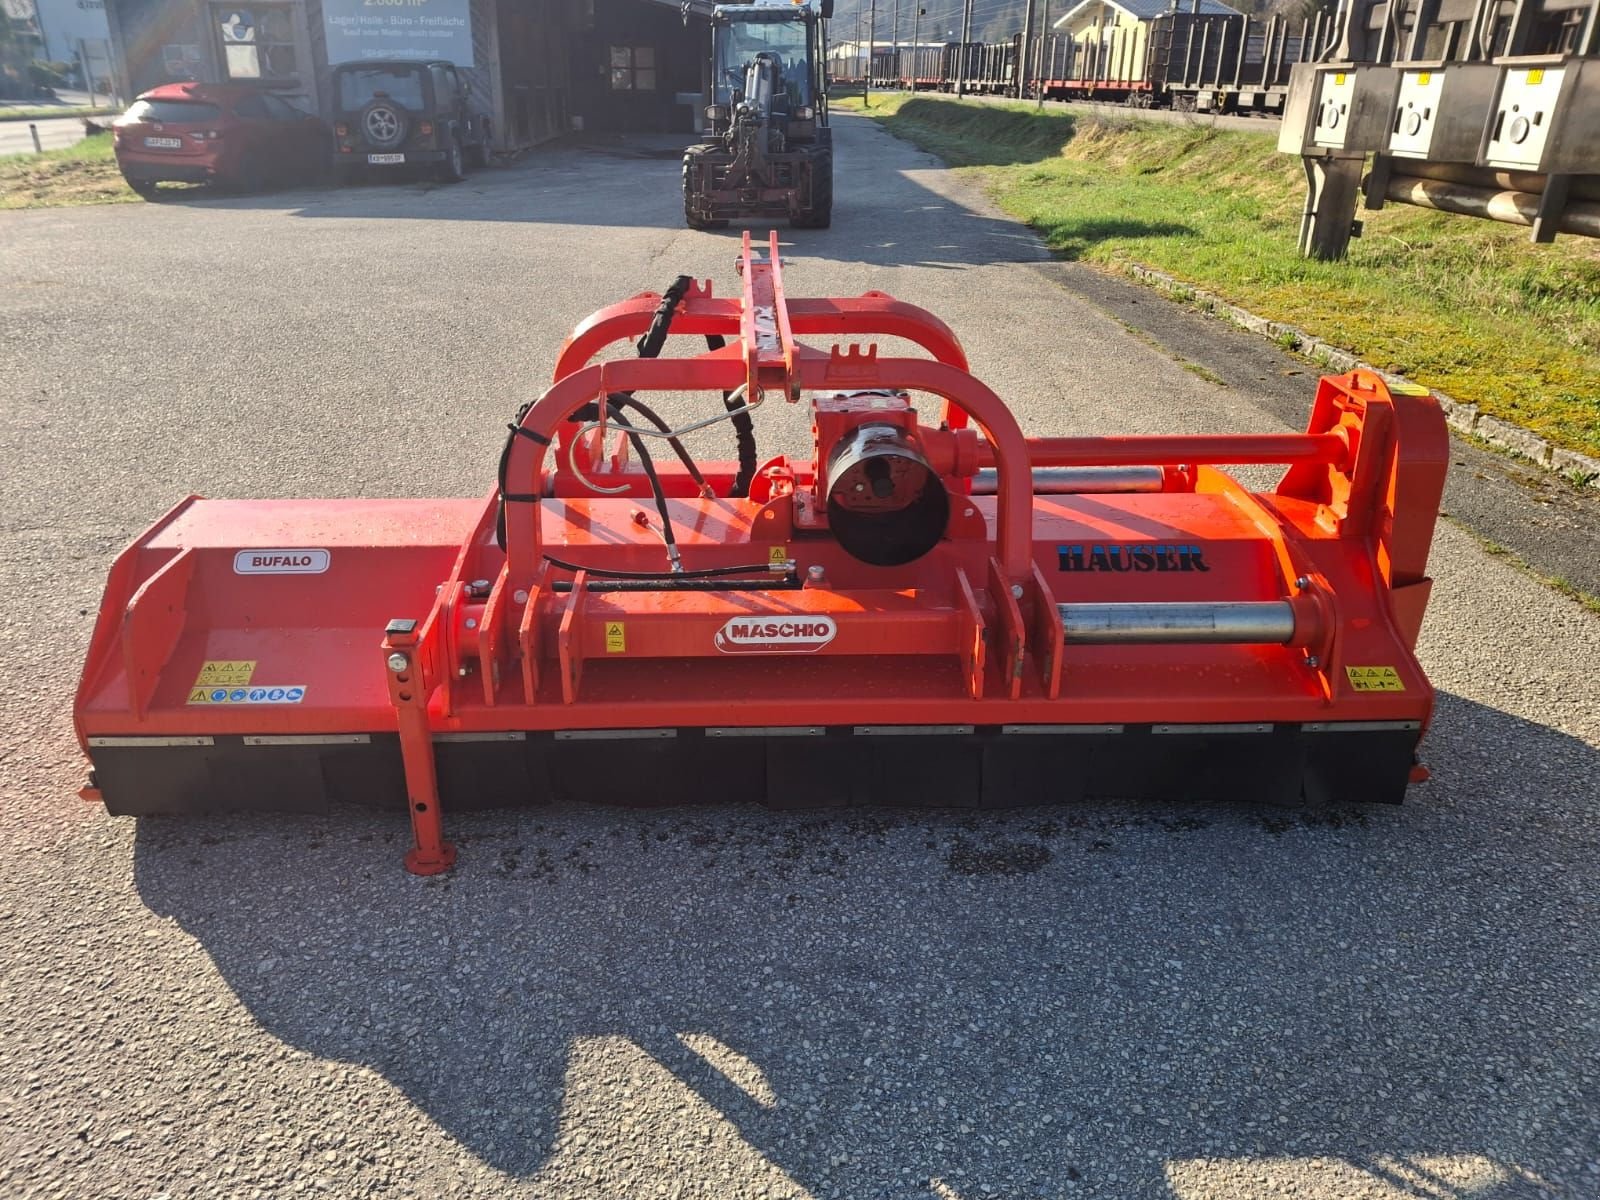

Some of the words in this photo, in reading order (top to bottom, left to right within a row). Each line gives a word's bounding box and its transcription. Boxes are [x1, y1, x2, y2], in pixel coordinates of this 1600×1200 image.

[251, 556, 312, 567] BUFALO
[1056, 545, 1210, 572] HAUSER
[731, 623, 830, 638] MASCHIO
